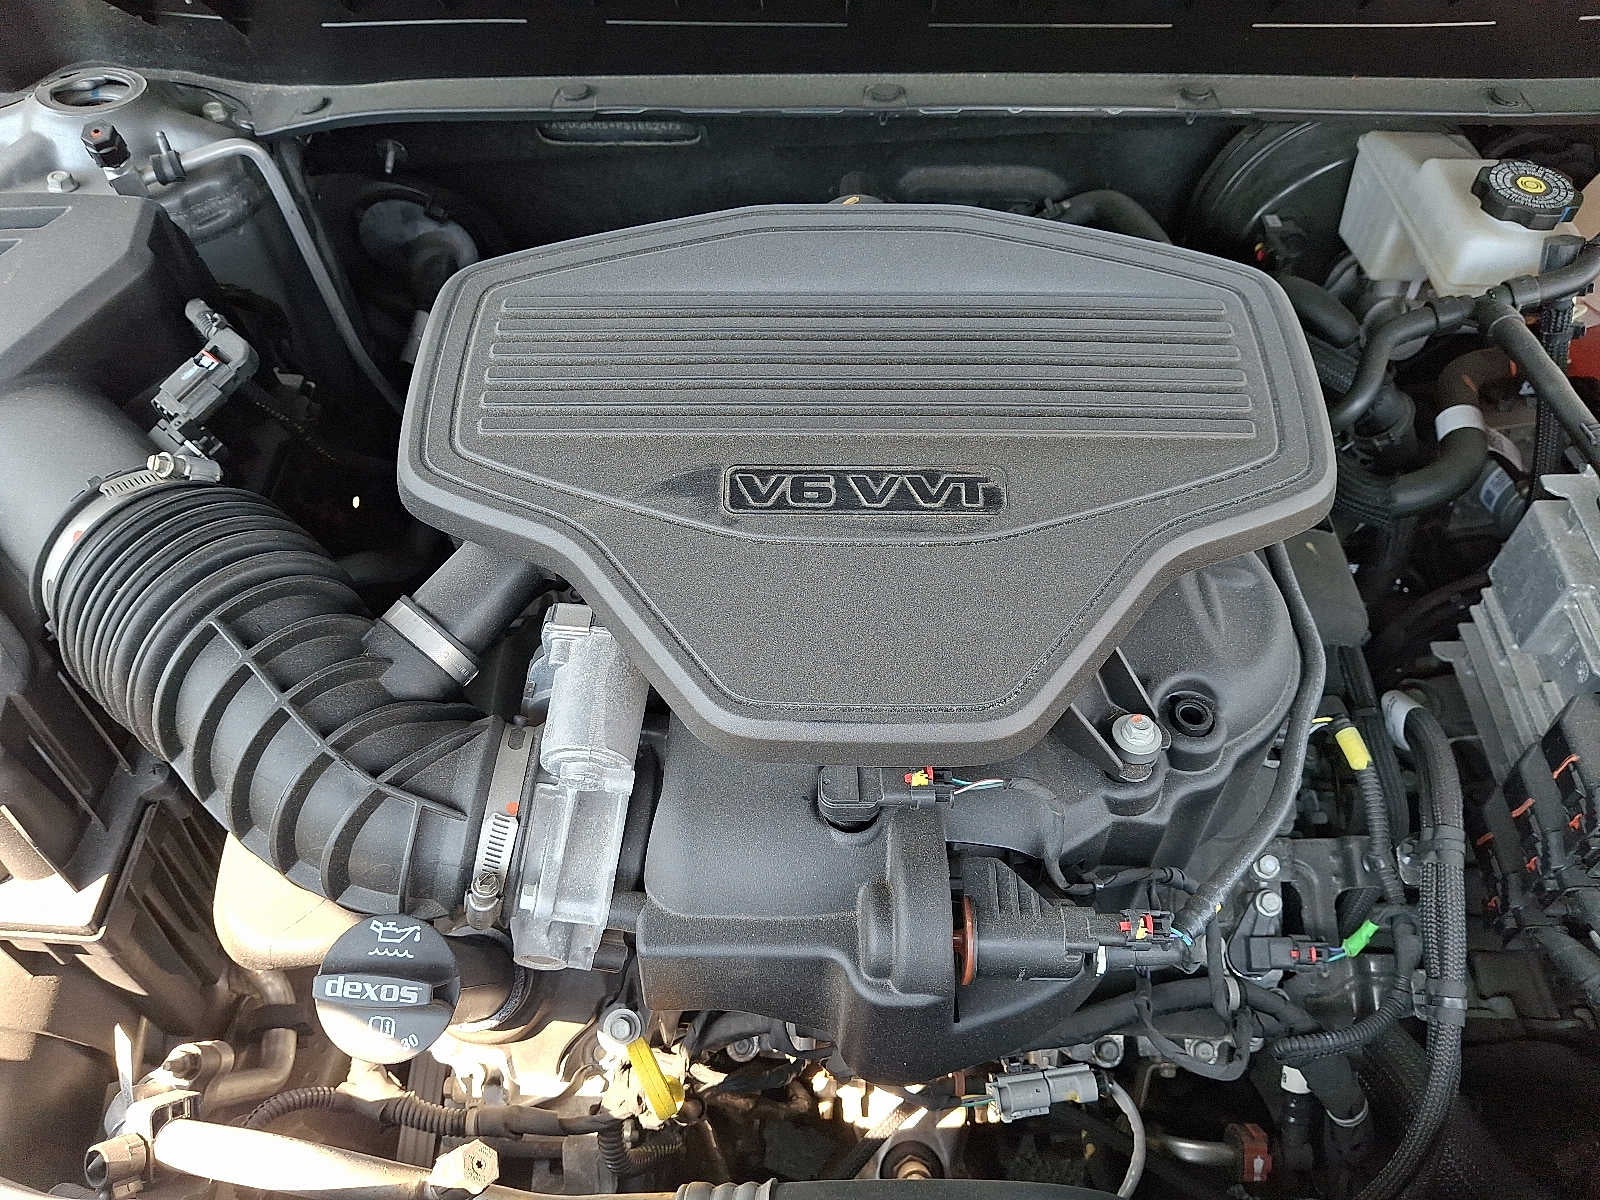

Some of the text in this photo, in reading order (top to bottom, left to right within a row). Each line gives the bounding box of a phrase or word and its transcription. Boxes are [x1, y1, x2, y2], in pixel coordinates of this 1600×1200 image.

[735, 474, 991, 508] V6 VVT
[325, 976, 419, 1004] dexos
